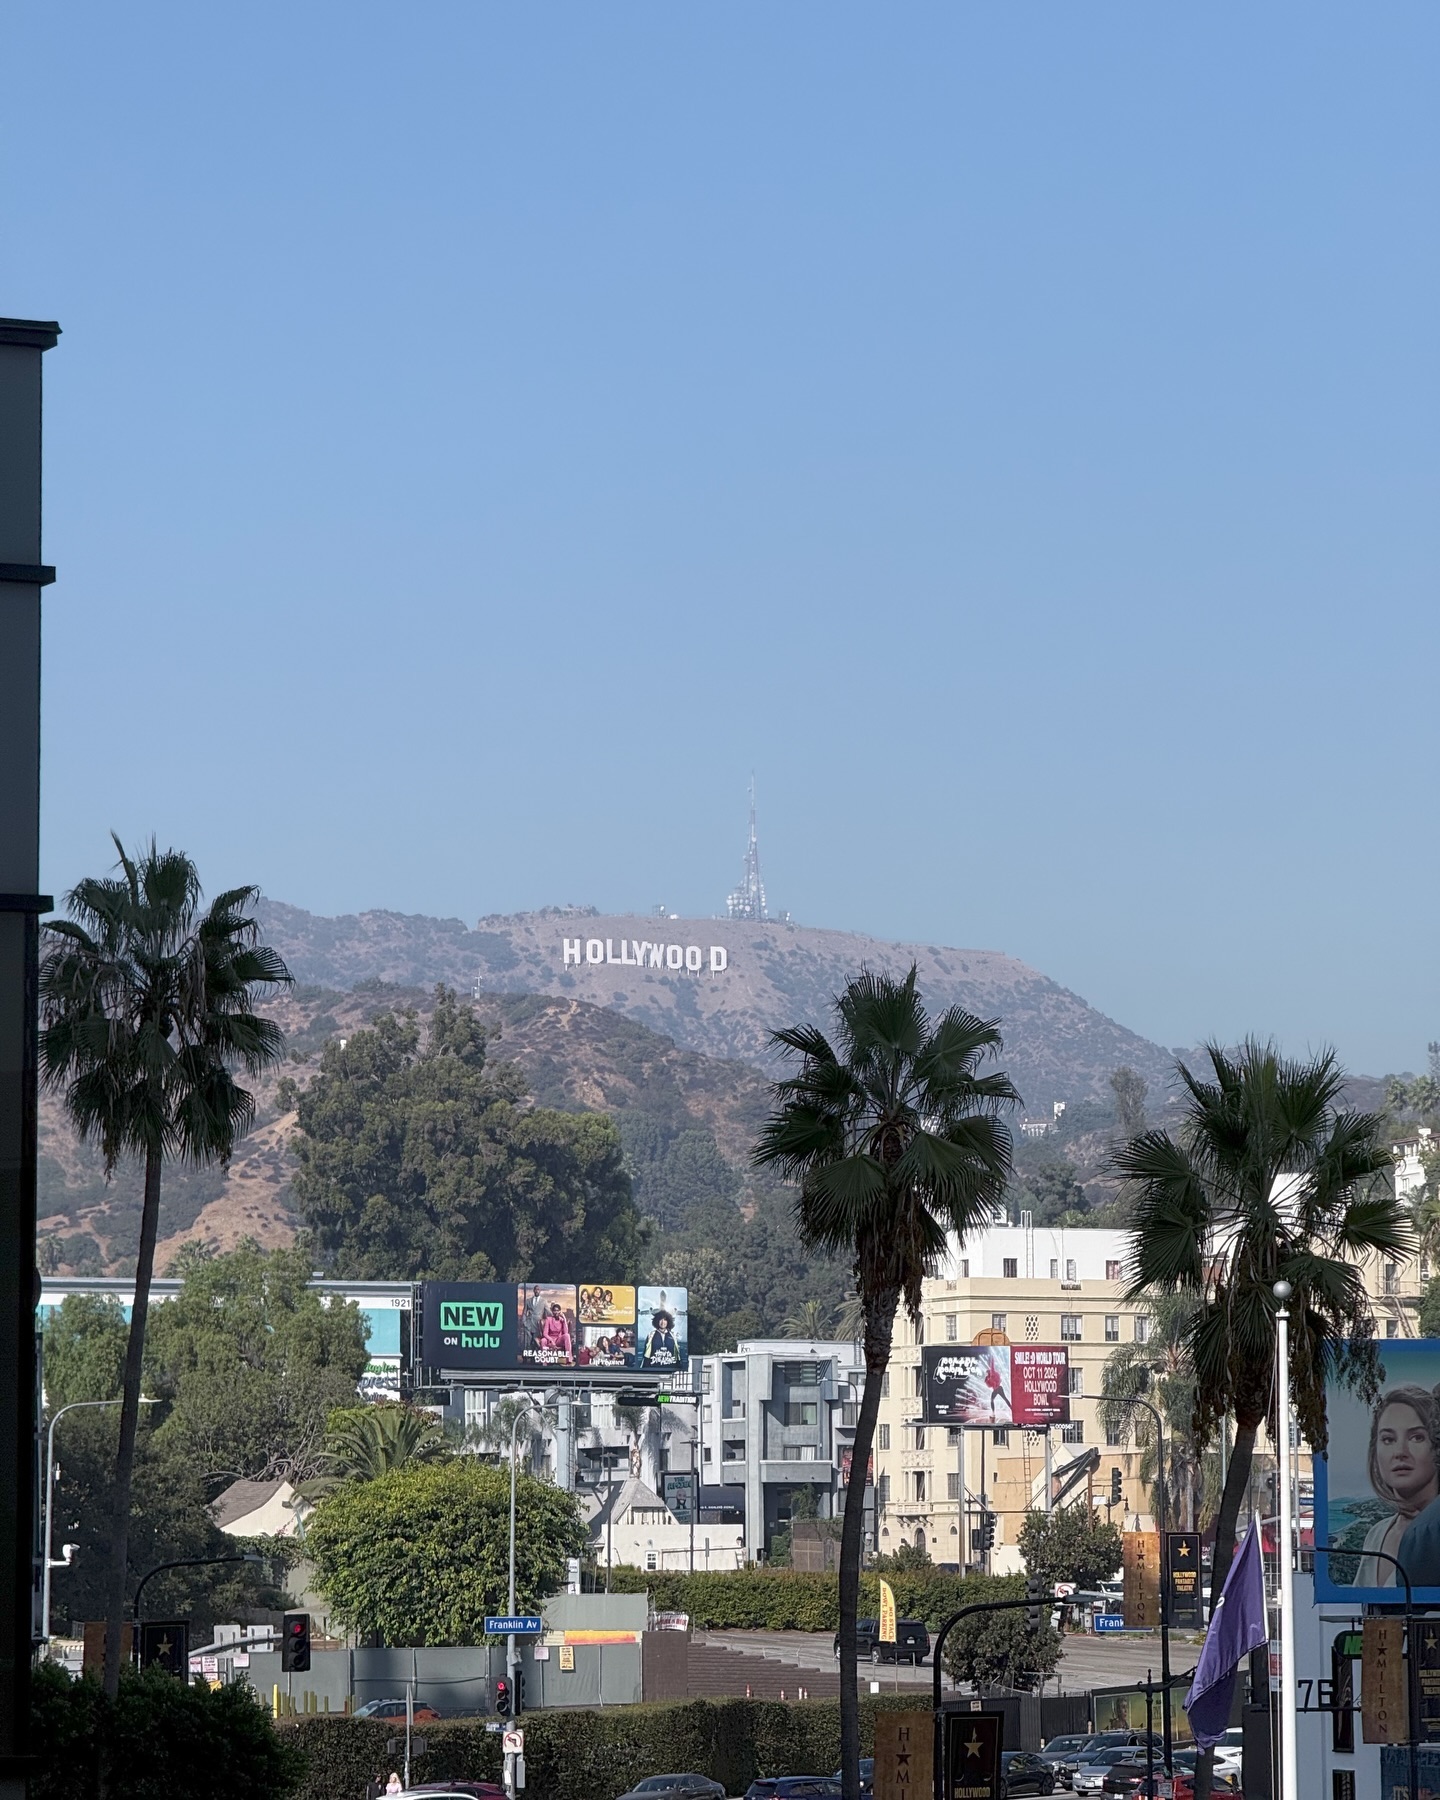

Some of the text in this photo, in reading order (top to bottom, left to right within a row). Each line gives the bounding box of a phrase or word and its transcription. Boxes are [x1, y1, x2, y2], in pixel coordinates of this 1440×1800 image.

[563, 938, 728, 972] HOLLYWOOD
[390, 1299, 411, 1308] 1921
[443, 1306, 500, 1327] NEW
[443, 1332, 500, 1348] ON hulu
[523, 1349, 570, 1358] REASONABLE
[534, 1356, 559, 1364] DOUBT
[1036, 1351, 1053, 1365] WORLD
[1052, 1351, 1066, 1365] TOUR
[1023, 1366, 1058, 1379] OCT 11 2024
[1024, 1380, 1057, 1393] HOLLYWOOD
[1033, 1393, 1049, 1406] BOWL
[489, 1620, 538, 1629] Franklin Av
[1099, 1618, 1124, 1628] Frank
[954, 1787, 991, 1799] HOLLYWOOD
